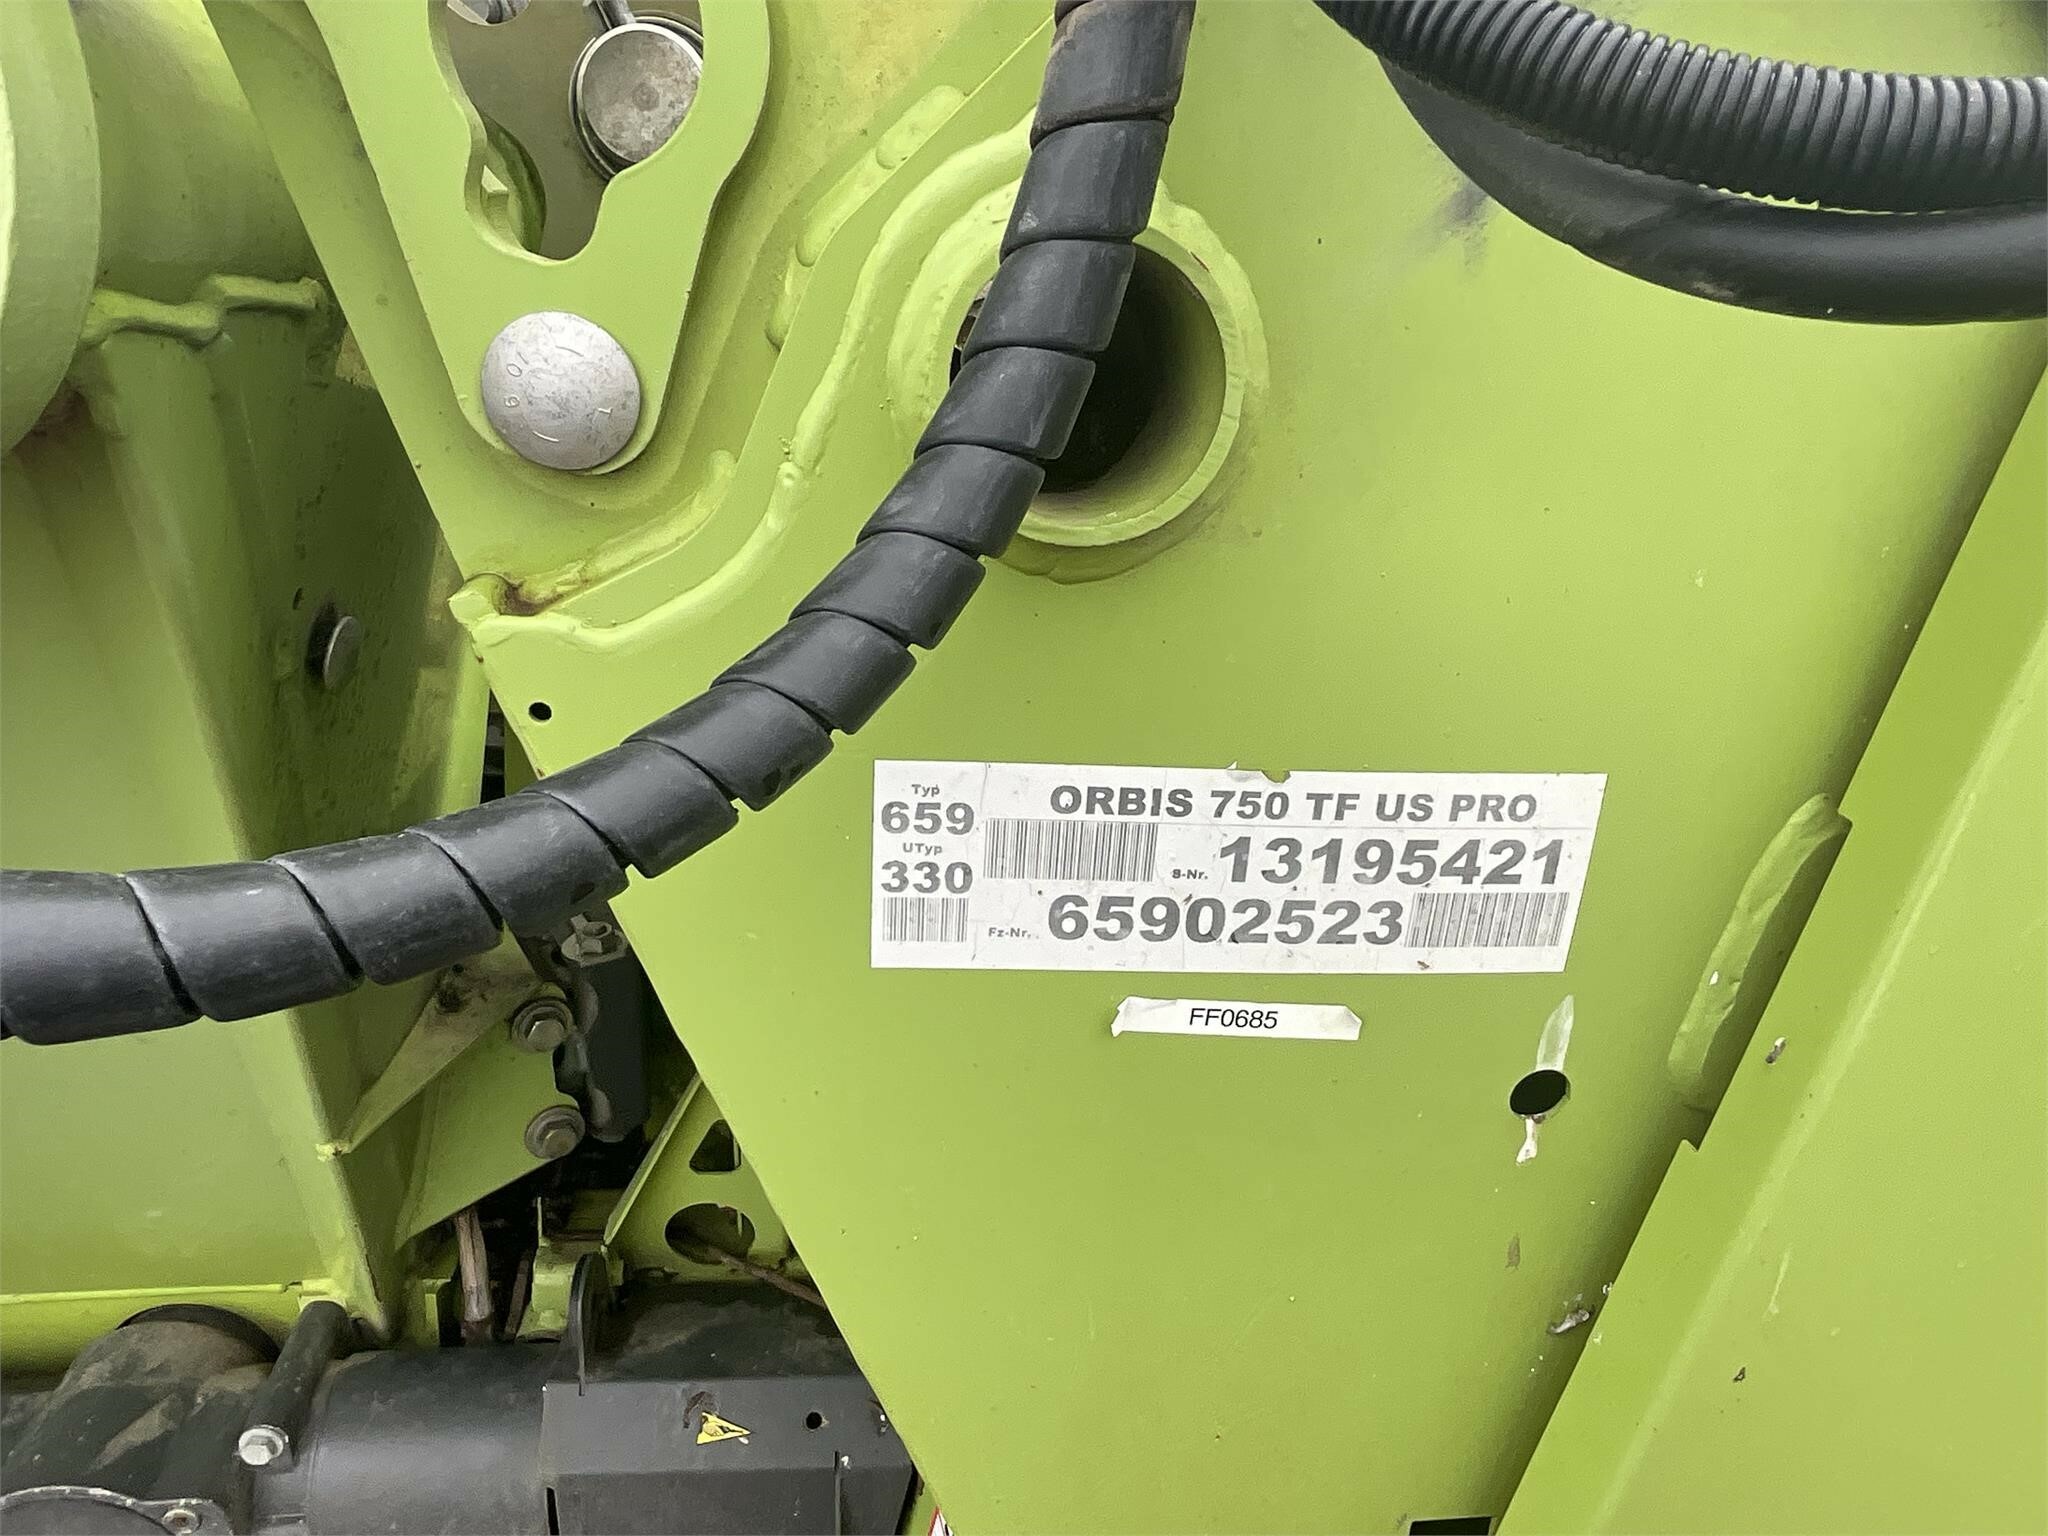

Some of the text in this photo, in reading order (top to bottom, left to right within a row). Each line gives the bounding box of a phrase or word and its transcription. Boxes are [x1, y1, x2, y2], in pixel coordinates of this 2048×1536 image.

[911, 784, 941, 797] Typ
[1050, 785, 1538, 823] ORBIS 750 TF US PRO
[881, 801, 975, 835] 659
[902, 843, 943, 855] UTyp
[1172, 836, 1564, 886] S-Nr. 13195421
[881, 860, 973, 894] 330
[1048, 895, 1404, 944] 65902523
[1189, 1008, 1278, 1029] FF0685
